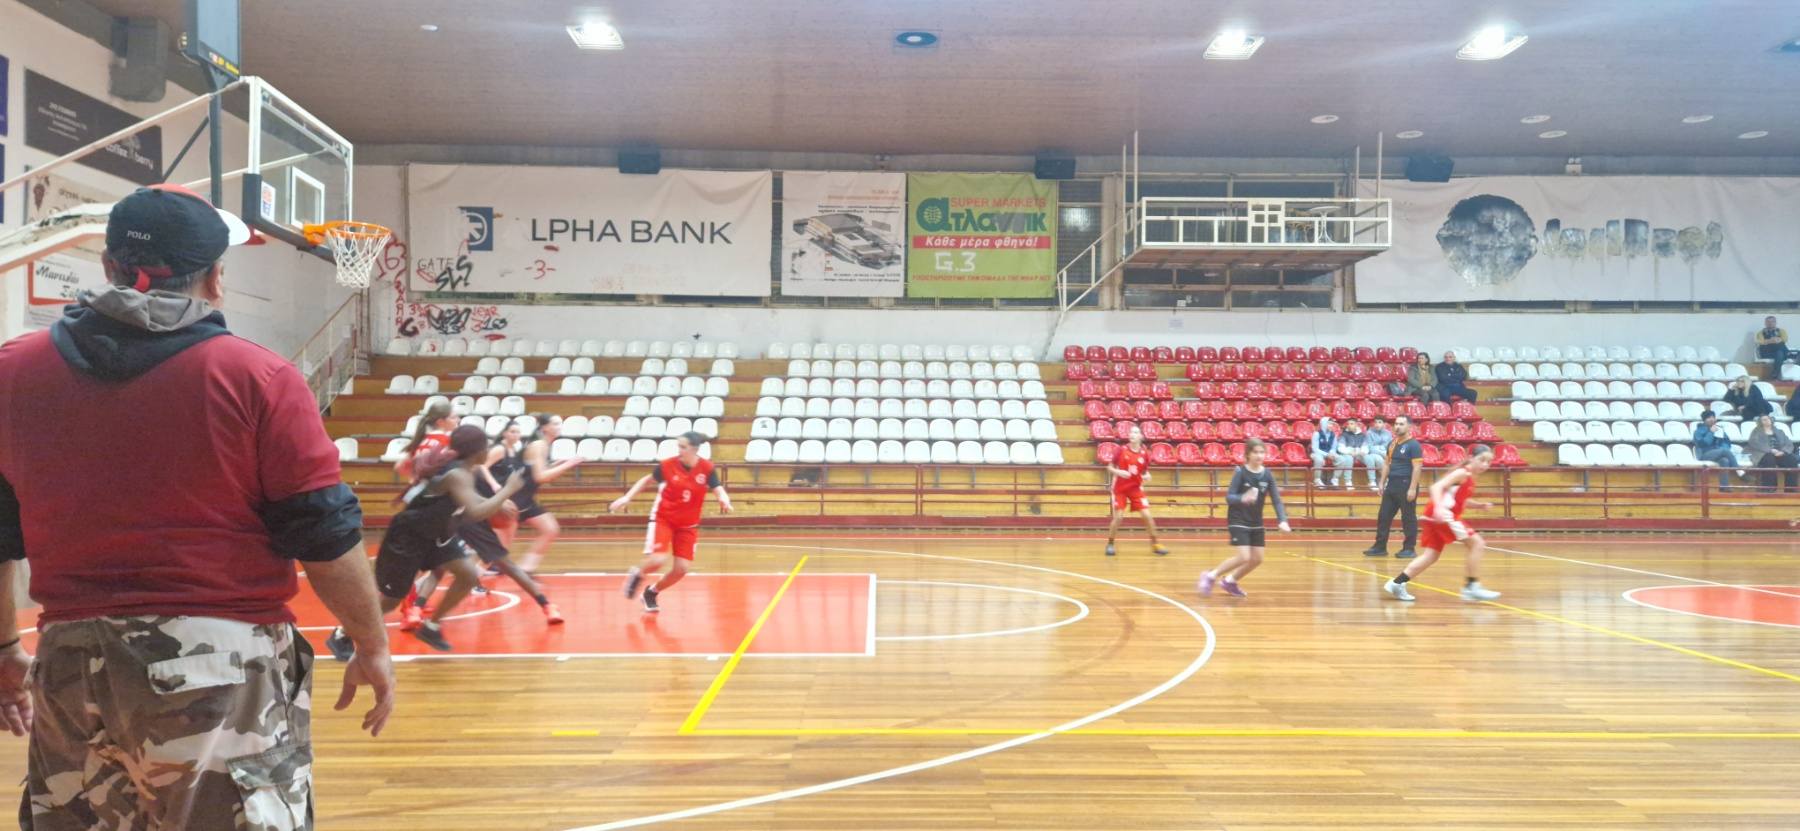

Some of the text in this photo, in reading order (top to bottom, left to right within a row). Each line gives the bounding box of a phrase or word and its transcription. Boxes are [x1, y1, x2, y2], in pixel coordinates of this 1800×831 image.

[951, 197, 1047, 208] SUPER MARKETS
[127, 230, 151, 241] POLO
[630, 220, 733, 244] BANK
[925, 236, 1039, 248] Κάθε μέρα φθηνά!
[417, 257, 454, 271] GATE
[935, 252, 977, 272] G.3
[682, 489, 691, 503] 9
